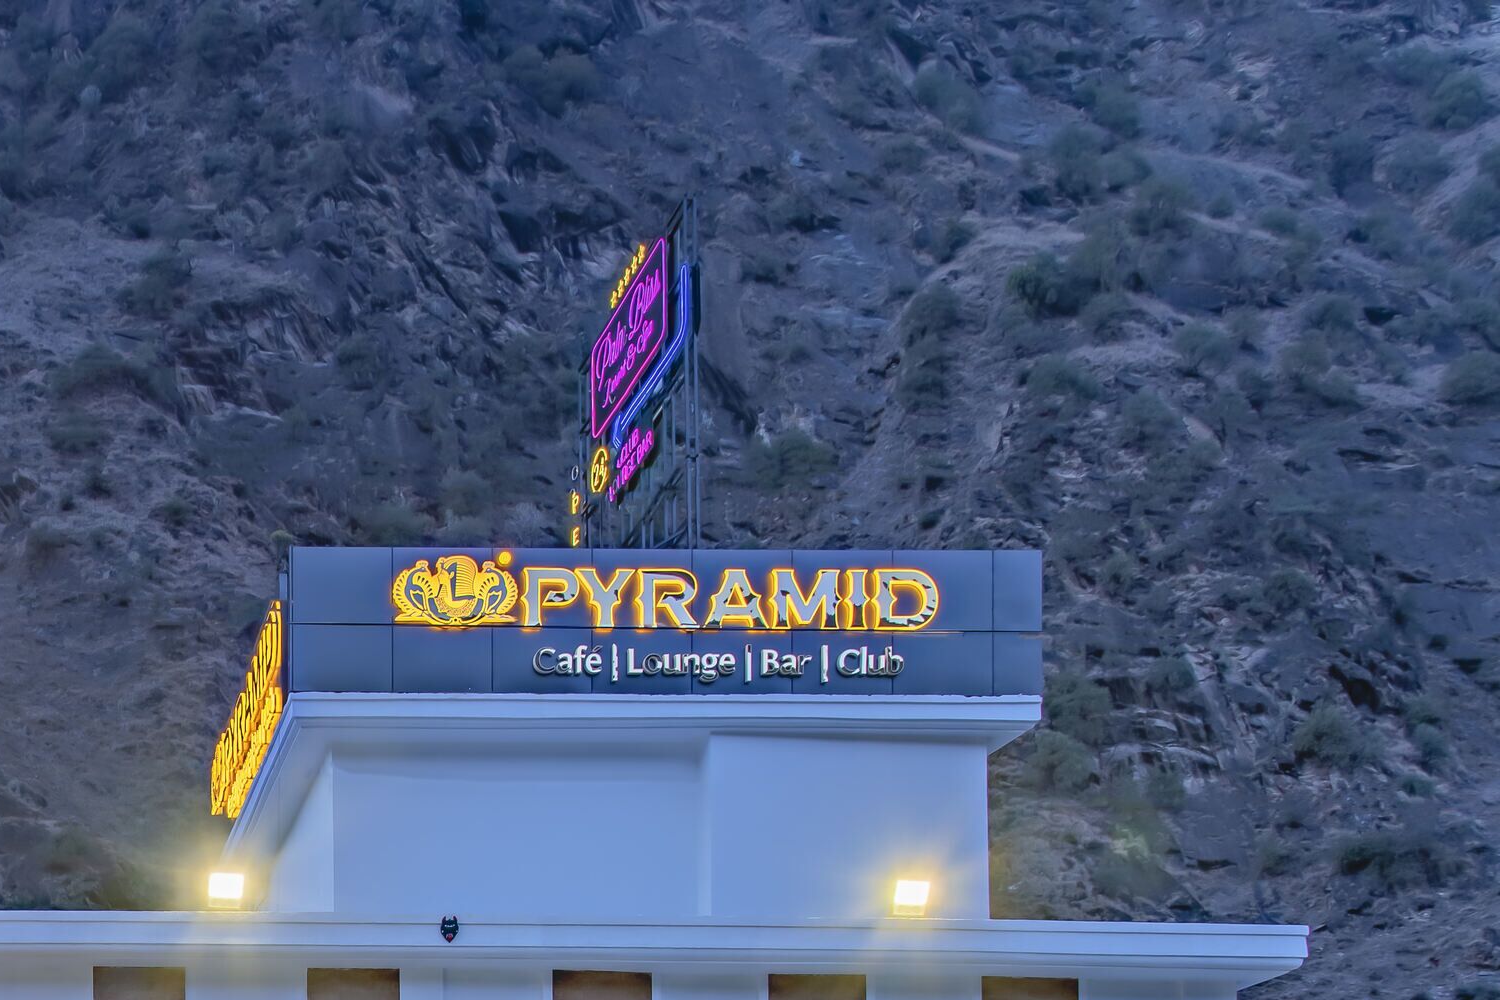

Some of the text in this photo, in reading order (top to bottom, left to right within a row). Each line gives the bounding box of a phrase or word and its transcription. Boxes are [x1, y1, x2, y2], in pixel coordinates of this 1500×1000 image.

[596, 268, 662, 392] Palm Bliss
[520, 566, 940, 631] PYRAMID
[533, 644, 905, 683] Café Lounge Bar Club
